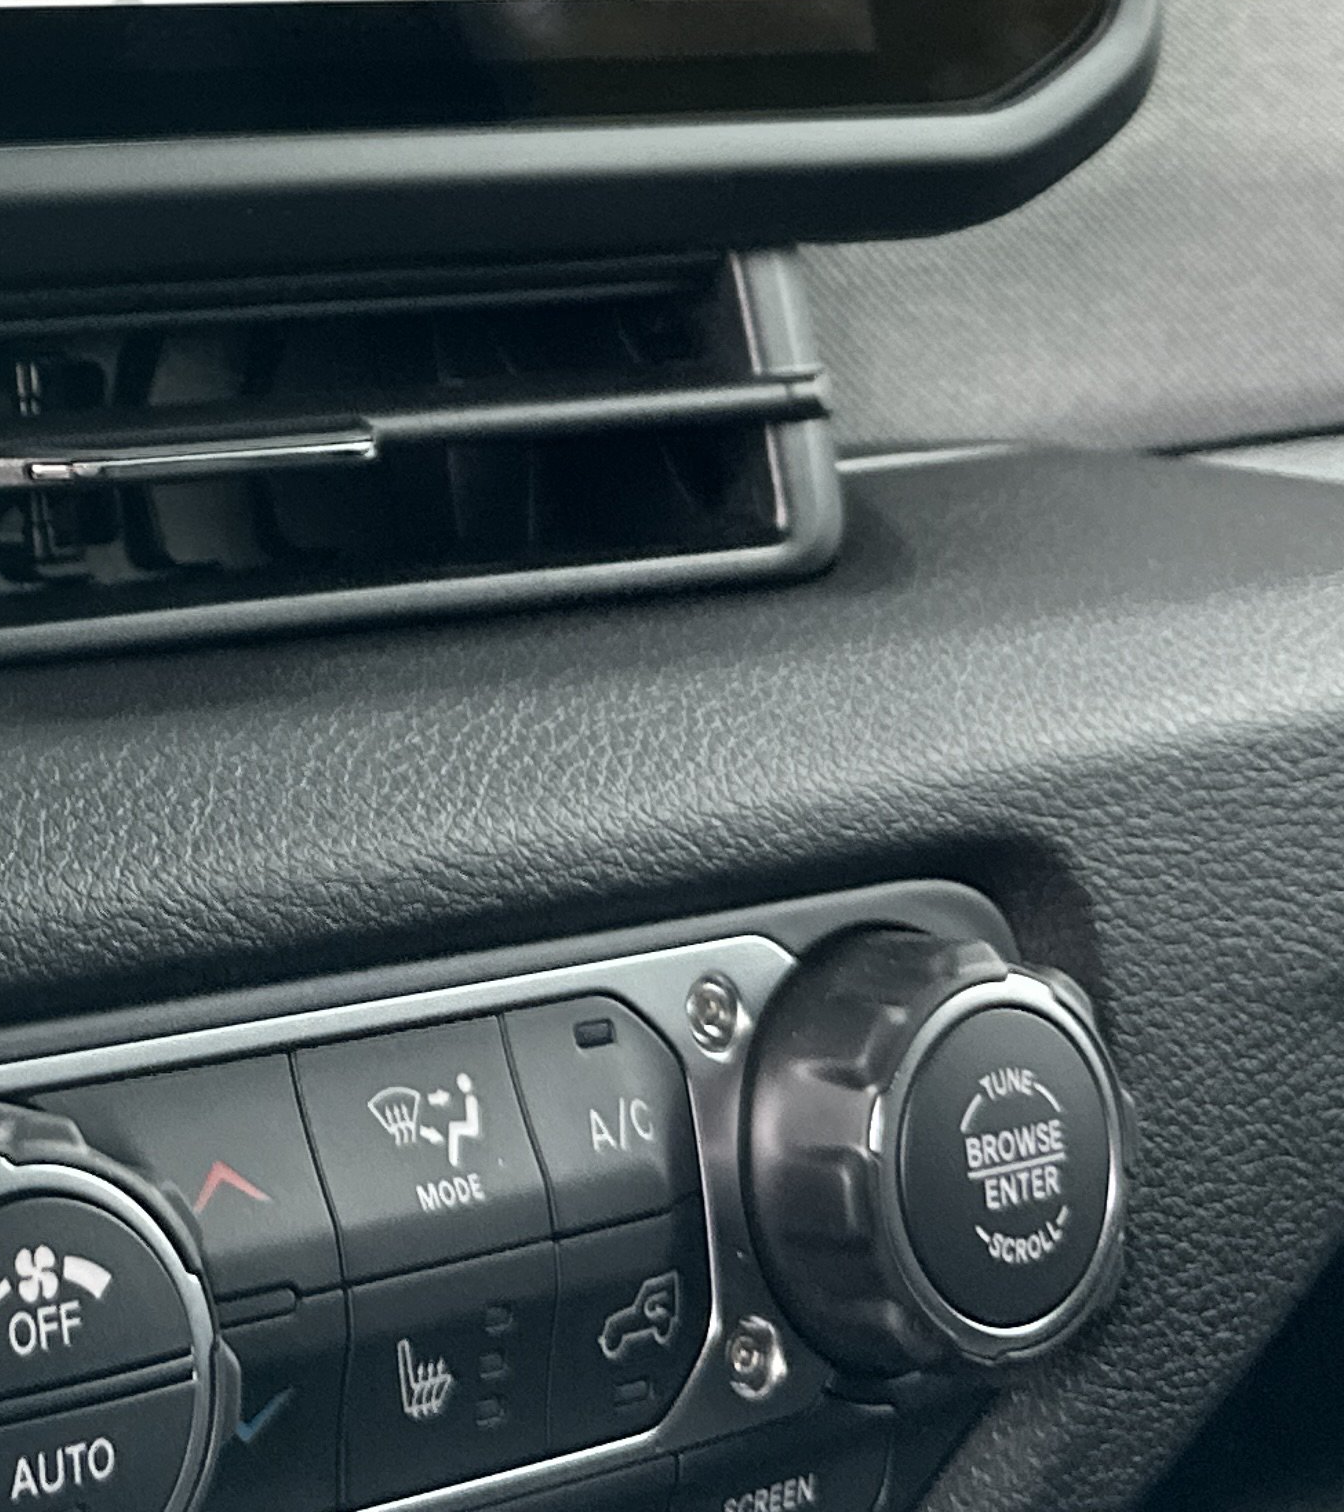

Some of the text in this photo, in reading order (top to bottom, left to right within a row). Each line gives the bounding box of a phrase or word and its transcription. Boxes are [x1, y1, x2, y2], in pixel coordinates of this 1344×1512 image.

[979, 1067, 1036, 1099] TUNE
[588, 1097, 656, 1155] A/C
[965, 1119, 1064, 1169] BROWSE
[416, 1173, 486, 1211] MODE
[984, 1165, 1061, 1211] ENTER
[987, 1221, 1064, 1265] SCROLL
[8, 1300, 84, 1357] OFF
[11, 1436, 115, 1502] AUTO
